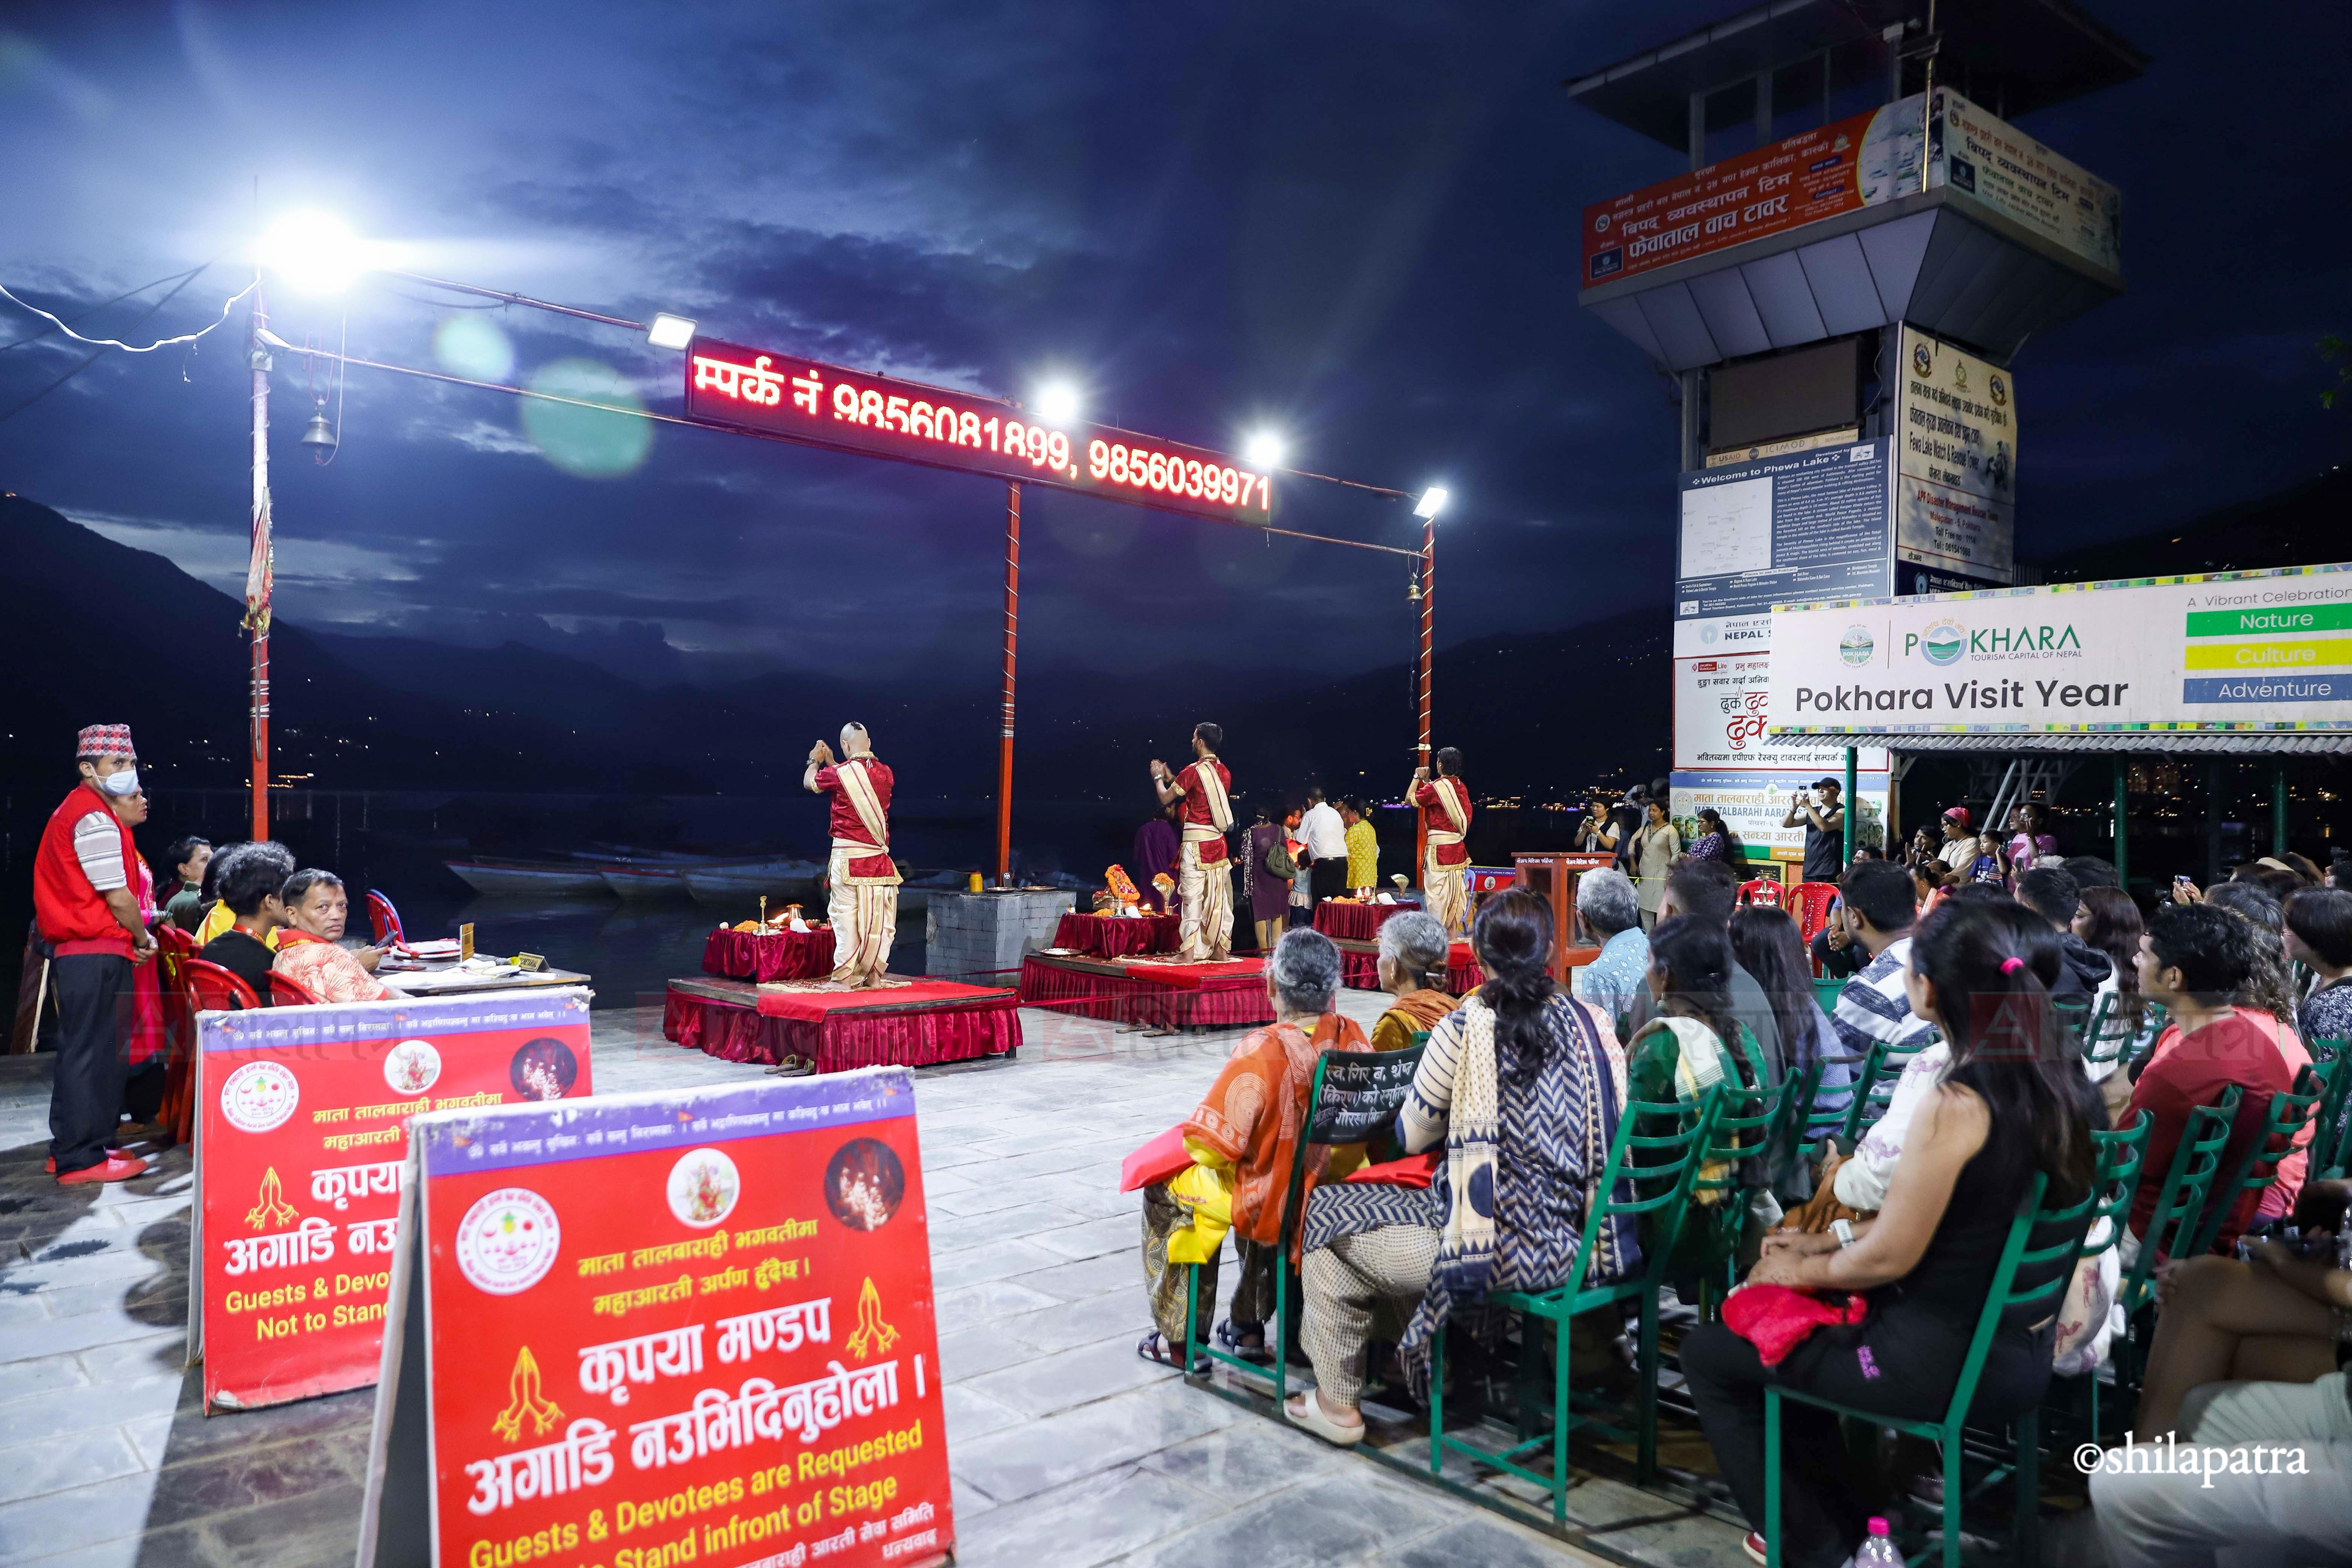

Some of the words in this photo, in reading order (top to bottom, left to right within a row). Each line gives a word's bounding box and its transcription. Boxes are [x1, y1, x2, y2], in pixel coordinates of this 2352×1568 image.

[1667, 185, 1749, 221] व्यवस्थापन
[1757, 171, 1793, 193] टिम
[1629, 221, 1701, 259] फेवाताल
[1705, 209, 1738, 236] वाच
[1743, 194, 1790, 223] टावर
[792, 369, 823, 414] नं
[1089, 439, 1270, 510] 9856039971
[1815, 448, 1842, 457] Developed
[1909, 431, 1922, 454] Fewa
[1922, 435, 1933, 457] Lake
[1701, 471, 1747, 485] Welcome
[1764, 461, 1800, 474] Phewa
[1802, 456, 1830, 467] Lake
[1719, 452, 1741, 462] USAID
[1935, 526, 1944, 537] Toll
[1944, 528, 1955, 540] Free
[2187, 597, 2197, 607] A
[2205, 593, 2258, 606] Vibrant
[2240, 613, 2314, 629] Nature
[1725, 630, 1764, 641] NEPAL
[1735, 663, 1746, 672] प्रभु
[1970, 653, 2006, 661] TOURISM
[2008, 652, 2040, 661] CAPITAL
[2056, 650, 2082, 658] NEPAL
[2235, 648, 2316, 664] Culture
[1732, 675, 1746, 685] गर्दा
[2218, 681, 2332, 699] Adventure
[1796, 684, 1933, 712] Pokhara
[1944, 678, 2024, 710] Visit
[2035, 679, 2129, 708] Year
[1697, 751, 1730, 762] भवितव्यमा
[1732, 752, 1755, 761] एपीएफ
[1780, 751, 1813, 762] टावरलाई
[1814, 752, 1839, 762] सम्पर्क
[1694, 793, 1714, 804] माता
[1717, 792, 1765, 806] तालबाराही
[1718, 806, 1763, 817] TALBARAHI
[1742, 830, 1772, 841] सन्ध्या
[1775, 830, 1804, 842] आरती
[313, 1108, 349, 1124] माता
[354, 1100, 430, 1120] तालबाराही
[435, 1091, 503, 1111] भगवतीमा
[1361, 1083, 1381, 1105] को
[324, 1125, 401, 1151] महाआरती
[310, 1159, 407, 1211] कृपया
[223, 1216, 338, 1277] अगाडि
[577, 1252, 627, 1278] माता
[734, 1217, 819, 1249] भगवतीमा
[225, 1283, 306, 1314] Guests
[312, 1277, 328, 1299] &
[593, 1274, 693, 1317] महाआरती
[698, 1265, 749, 1295] अर्पण
[256, 1311, 299, 1341] Not
[304, 1311, 327, 1333] to
[577, 1323, 706, 1406] कृपया
[715, 1296, 832, 1365] मण्डप
[464, 1416, 617, 1517] अगाडि
[628, 1359, 899, 1470] नउभिदिनुहोला
[468, 1522, 580, 1568] Guests
[586, 1508, 610, 1543] &
[616, 1476, 745, 1534] Devotees
[750, 1464, 792, 1496] are
[797, 1418, 923, 1482] Requested
[614, 1527, 697, 1568] Stand
[703, 1504, 793, 1555] infront
[797, 1490, 822, 1526] of
[828, 1475, 898, 1516] Stage
[810, 1526, 856, 1560] आरती
[858, 1518, 887, 1544] सेवा
[890, 1501, 935, 1530] समिति
[882, 1527, 938, 1561] धन्यवाद
